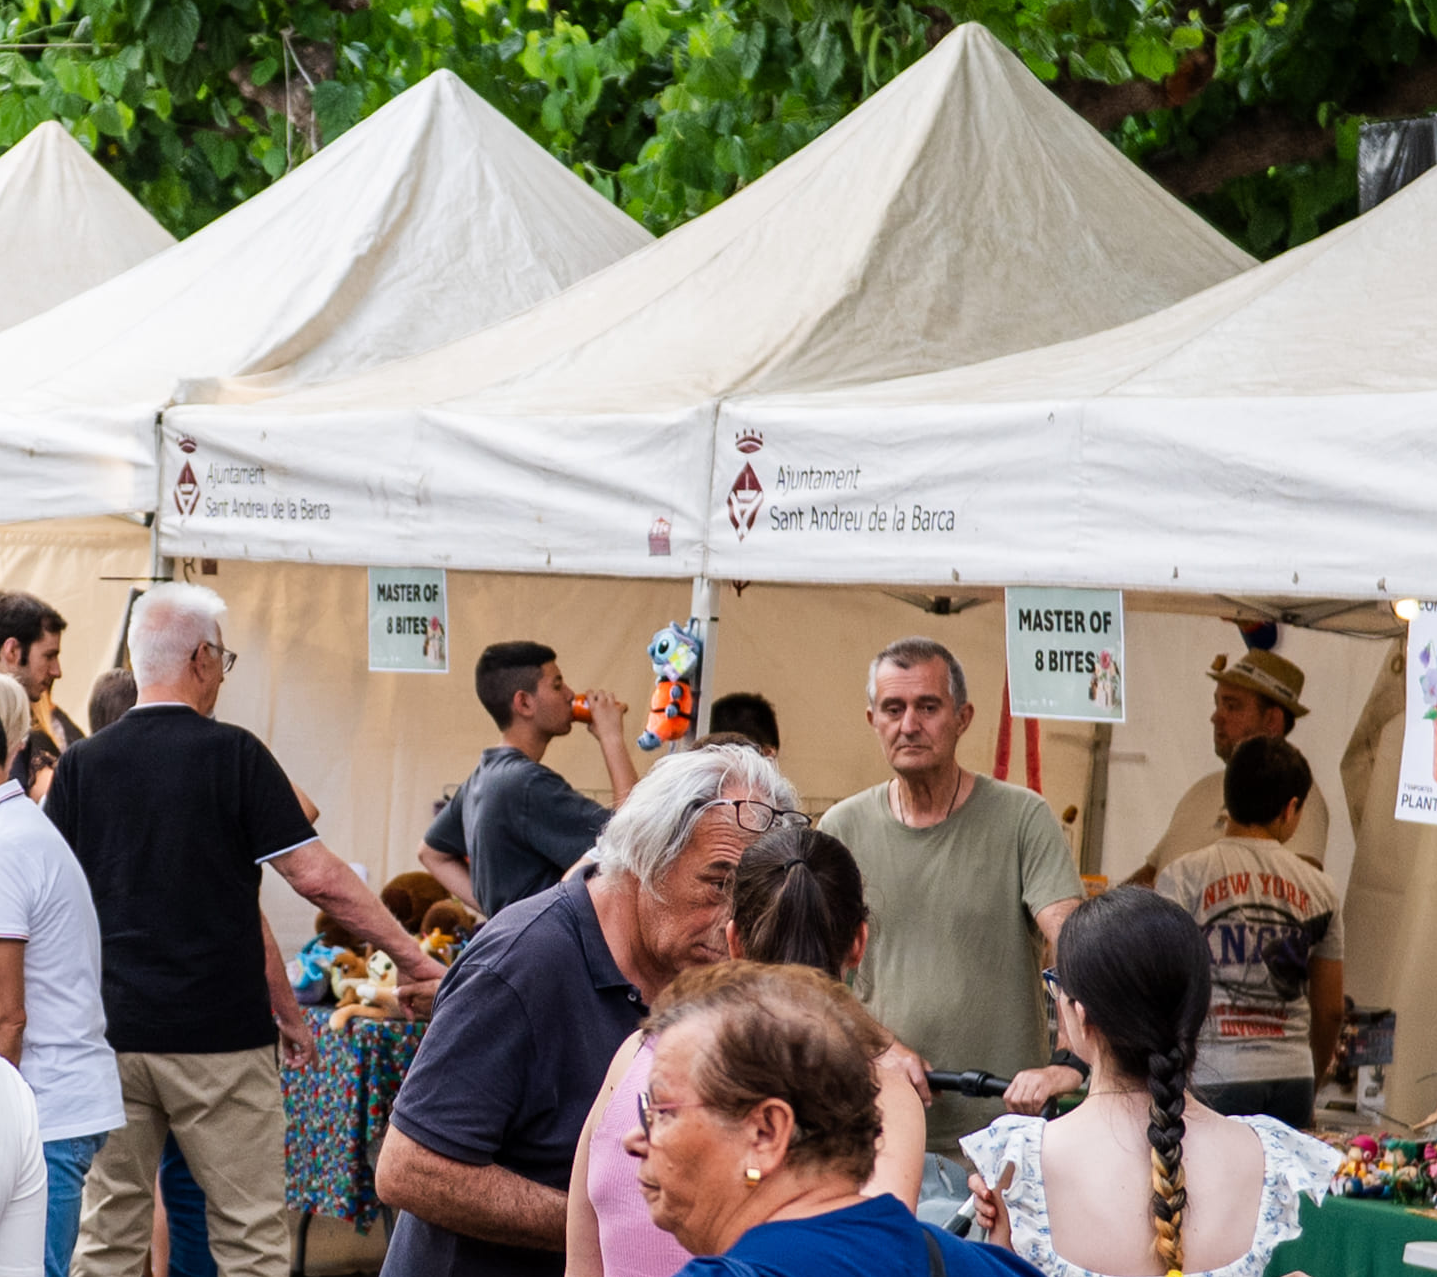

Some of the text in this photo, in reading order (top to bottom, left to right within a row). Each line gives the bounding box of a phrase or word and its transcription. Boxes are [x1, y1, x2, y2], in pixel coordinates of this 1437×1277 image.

[206, 463, 265, 489] Ajuntament
[775, 465, 861, 495] Ajuntament
[205, 496, 330, 520] Sant Andreu de la Barca
[769, 504, 956, 532] Sant Andreu de la Barca
[377, 584, 439, 602] MASTER OF
[387, 616, 428, 635] 8 BITES
[1019, 608, 1112, 634] MASTER OF
[1035, 649, 1096, 673] 8 BITES
[1203, 872, 1312, 915] NEW YORK
